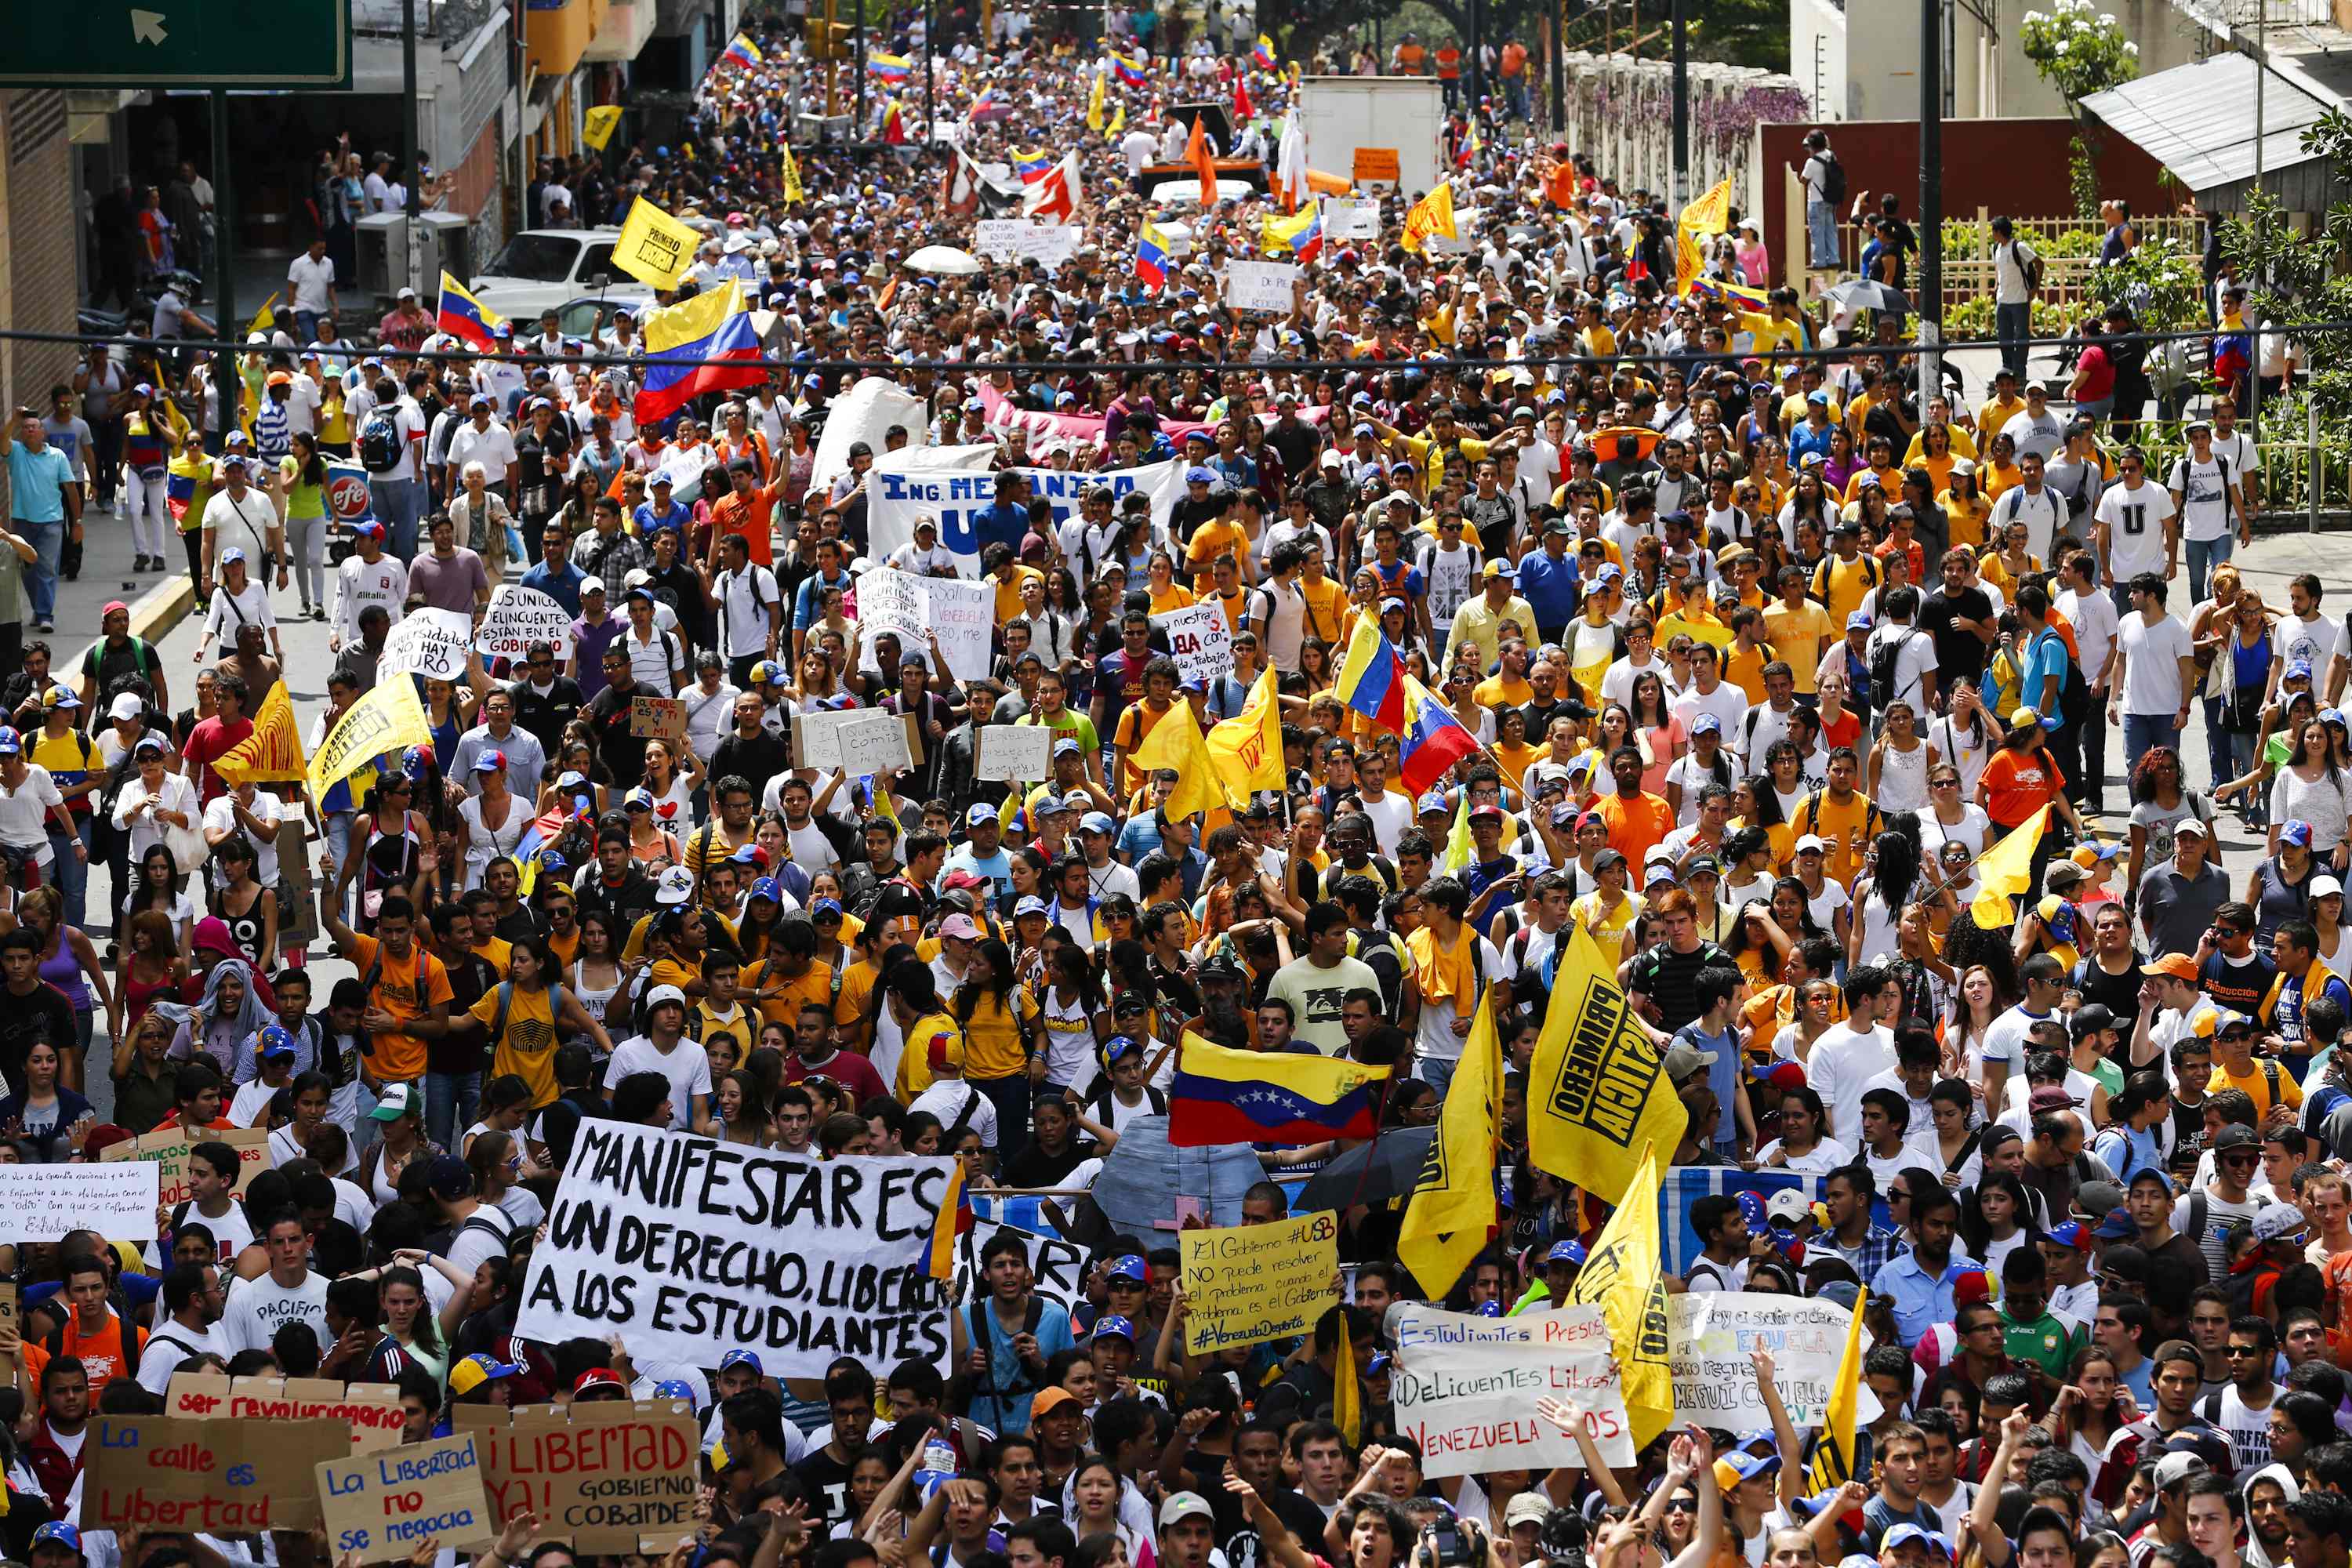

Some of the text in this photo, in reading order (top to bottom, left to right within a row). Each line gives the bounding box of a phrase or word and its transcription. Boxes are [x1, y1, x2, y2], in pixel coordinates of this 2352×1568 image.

[332, 483, 365, 511] efe
[2120, 501, 2147, 535] U
[357, 590, 387, 601] Alitalia
[526, 628, 542, 637] EN
[548, 626, 562, 637] EL
[421, 641, 448, 657] HAY
[571, 1126, 946, 1242] MANIFESTAR ES
[550, 1199, 612, 1256] UN
[1220, 1236, 1281, 1260] Gobierno
[1189, 1265, 1214, 1285] NO
[1317, 1264, 1330, 1279] el
[528, 1264, 948, 1365] A LOS ESTUDIANTES
[177, 1392, 221, 1414] ser
[101, 1421, 139, 1448] La
[1405, 1418, 1541, 1457] VENEZUELA
[147, 1442, 216, 1473] calle
[226, 1463, 256, 1487] es
[326, 1468, 365, 1497] La
[383, 1490, 423, 1515] no
[338, 1508, 474, 1552] se negocia
